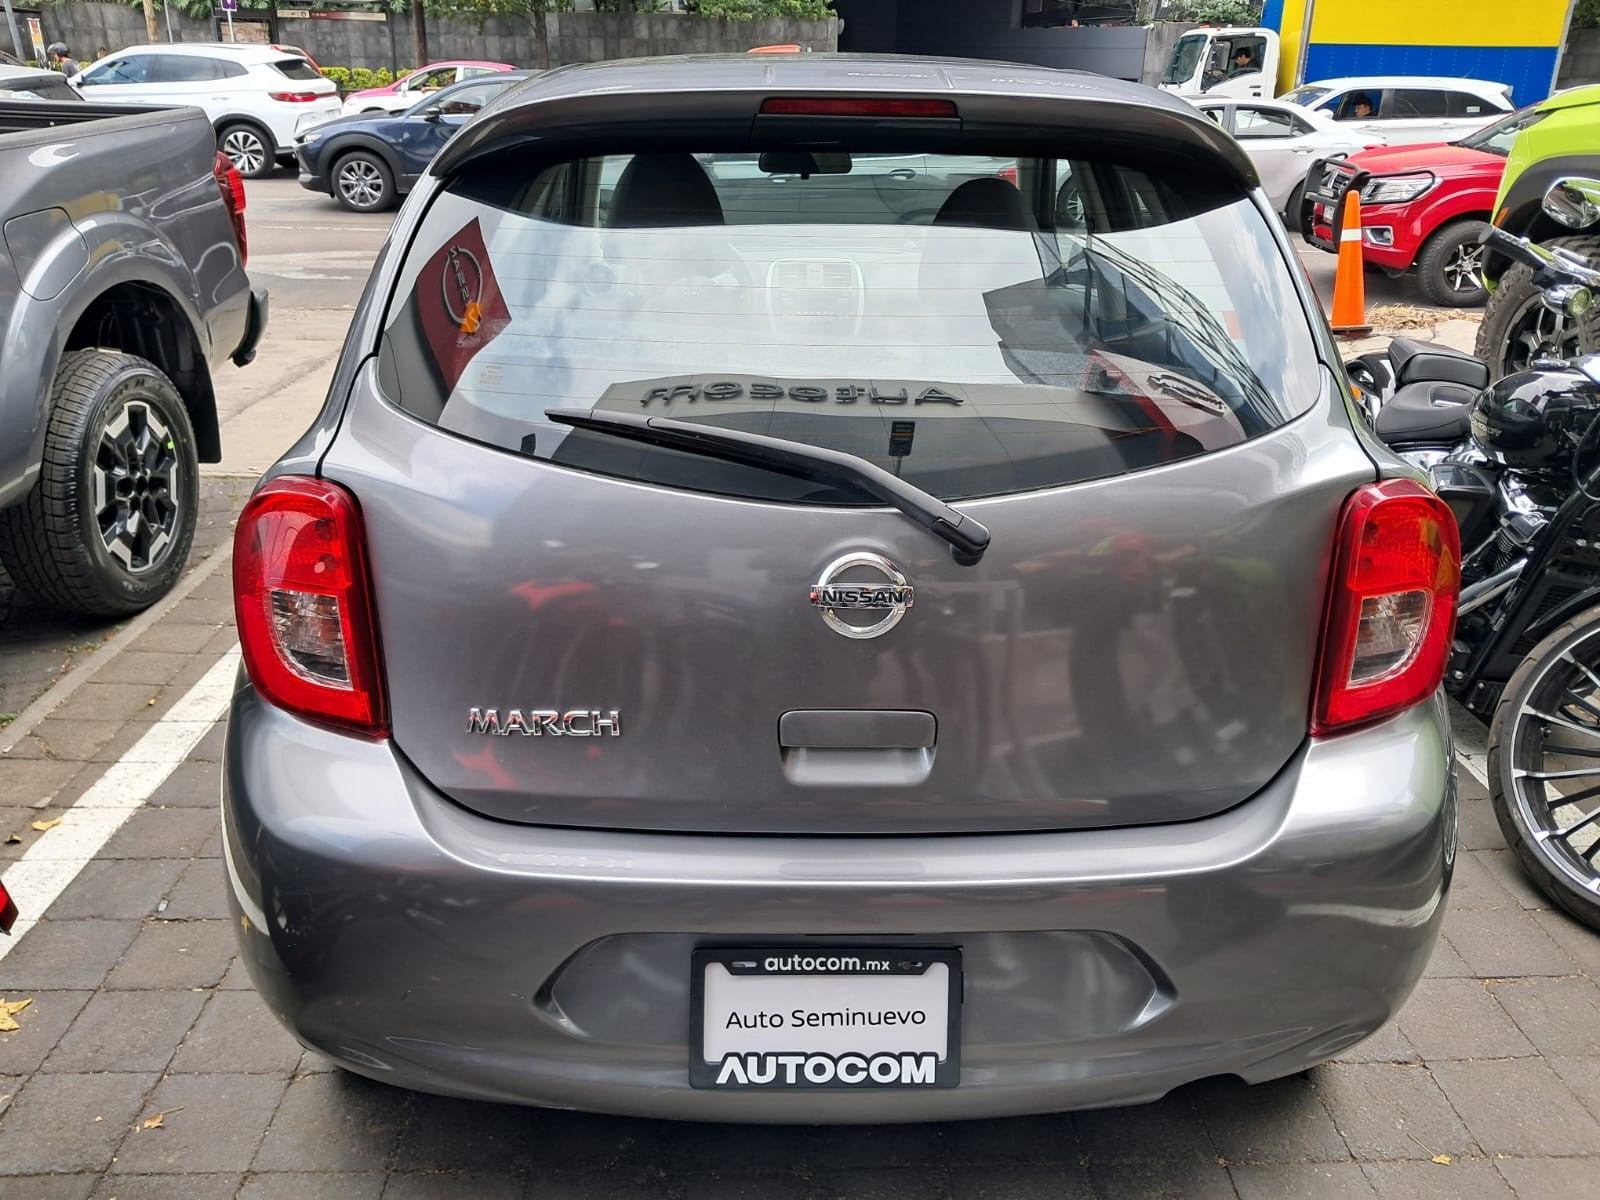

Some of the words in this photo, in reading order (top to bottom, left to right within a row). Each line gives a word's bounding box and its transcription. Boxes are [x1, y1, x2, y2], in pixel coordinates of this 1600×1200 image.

[822, 590, 903, 603] NISSAN
[465, 707, 620, 736] MARCH
[764, 954, 890, 971] autocom.mx
[726, 1011, 784, 1029] Auto
[791, 1008, 926, 1028] Seminuevo
[716, 1056, 936, 1084] AUTOCOM
